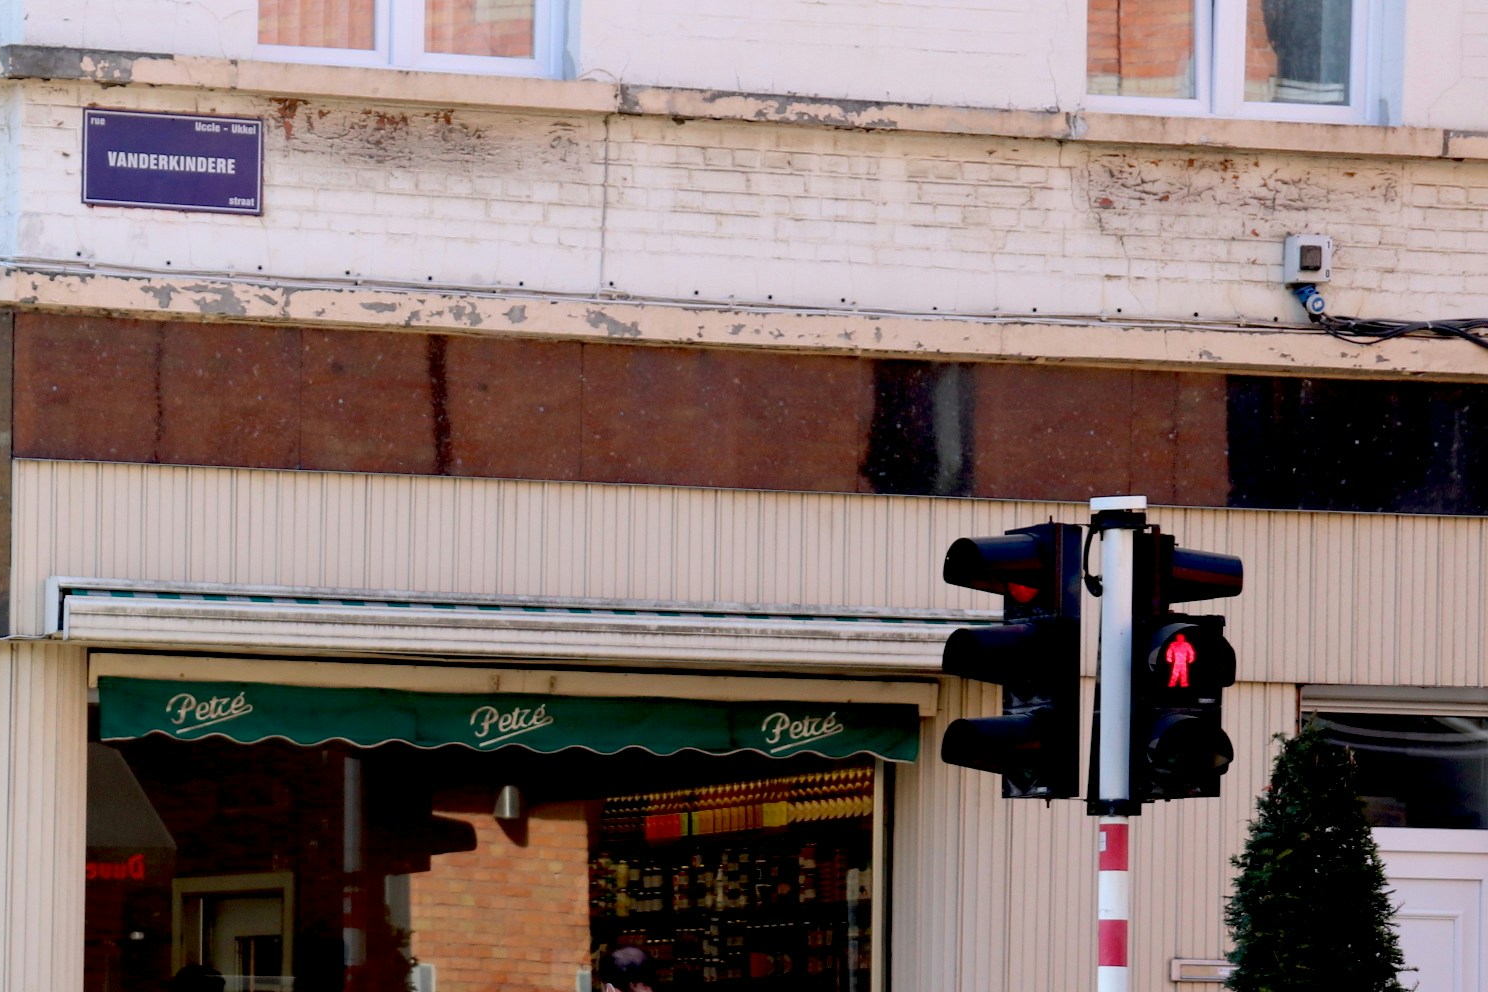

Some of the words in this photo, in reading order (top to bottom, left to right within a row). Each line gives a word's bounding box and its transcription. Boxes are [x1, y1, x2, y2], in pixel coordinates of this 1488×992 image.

[90, 116, 106, 126] rue
[195, 121, 221, 133] Uccle
[231, 123, 257, 135] Ukkel
[107, 150, 236, 174] VANDERKINDERE
[228, 196, 255, 206] straat
[165, 691, 253, 735] Petré
[469, 703, 554, 748] Petré
[761, 711, 845, 754] Petré
